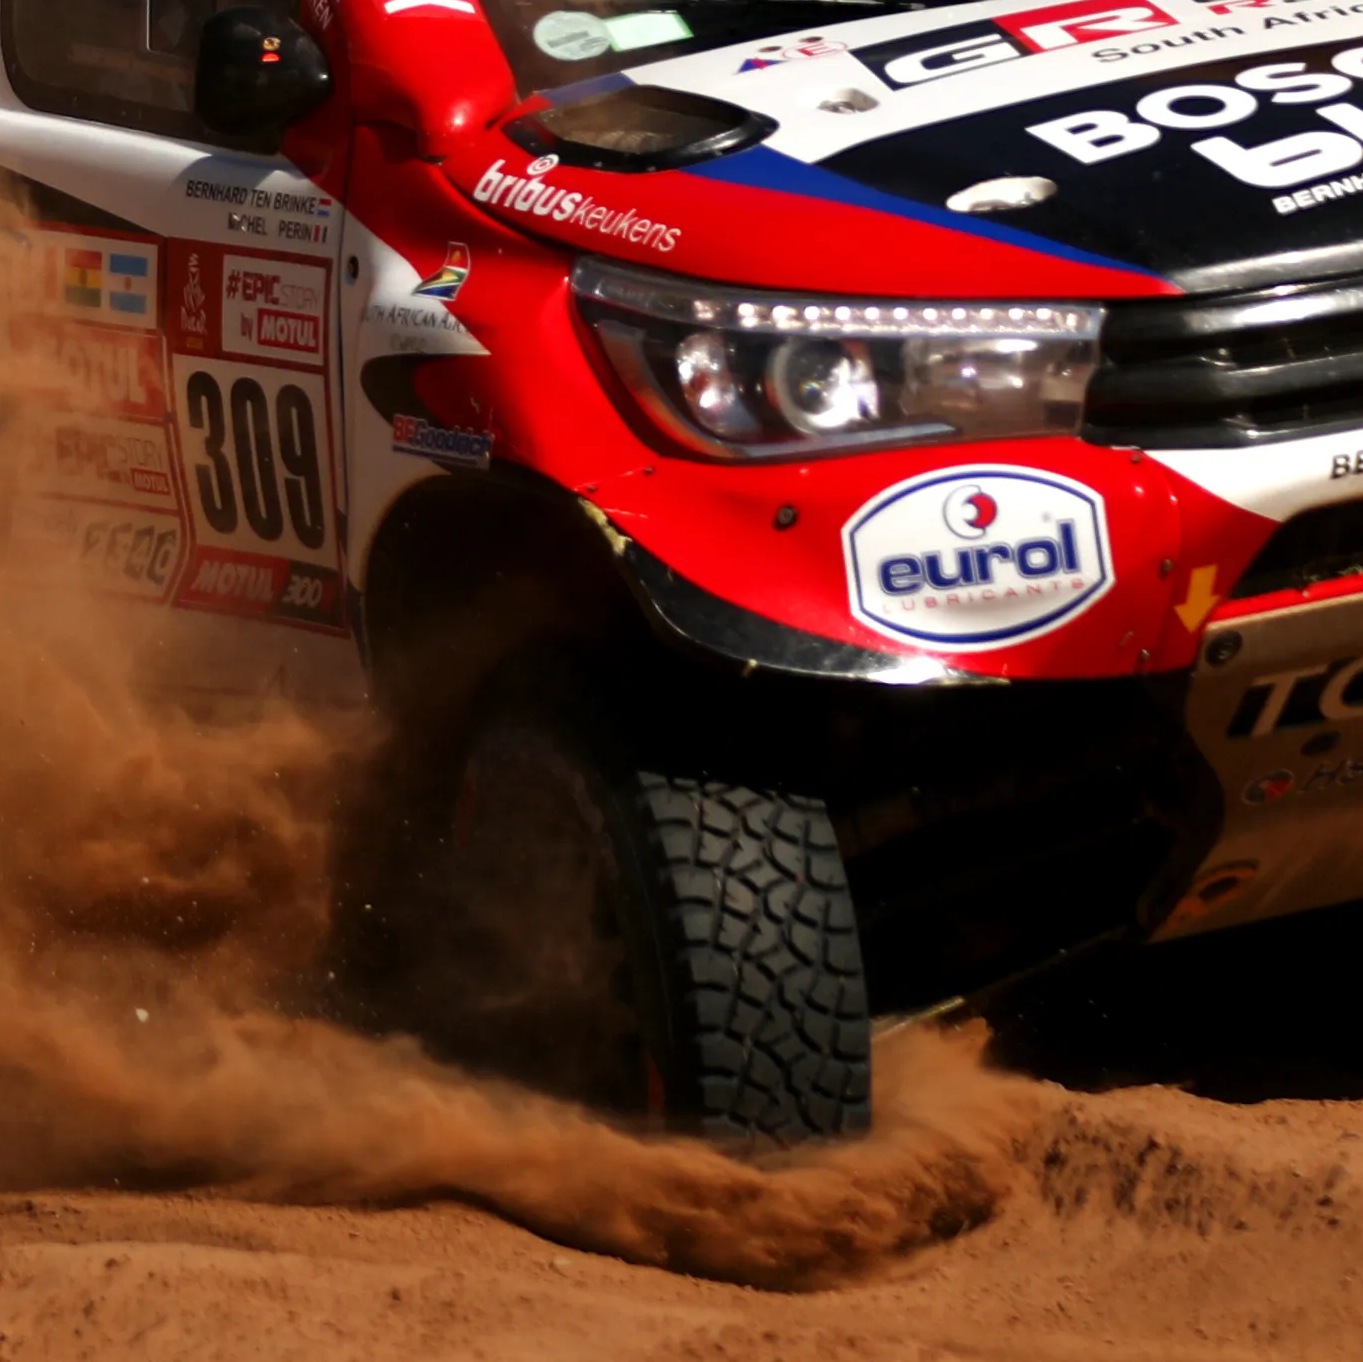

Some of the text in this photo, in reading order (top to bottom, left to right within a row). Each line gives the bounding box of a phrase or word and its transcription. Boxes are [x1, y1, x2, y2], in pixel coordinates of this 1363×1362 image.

[884, 5, 1172, 85] GR
[1091, 27, 1245, 64] South
[186, 180, 317, 216] BERNHARD TEN BRINKE
[278, 219, 312, 242] PERIN
[260, 313, 317, 347] MOTUL
[187, 370, 324, 550] 309
[878, 518, 1082, 597] eurol
[189, 559, 275, 602] MOTUL
[881, 577, 1087, 615] LUBRICANTS
